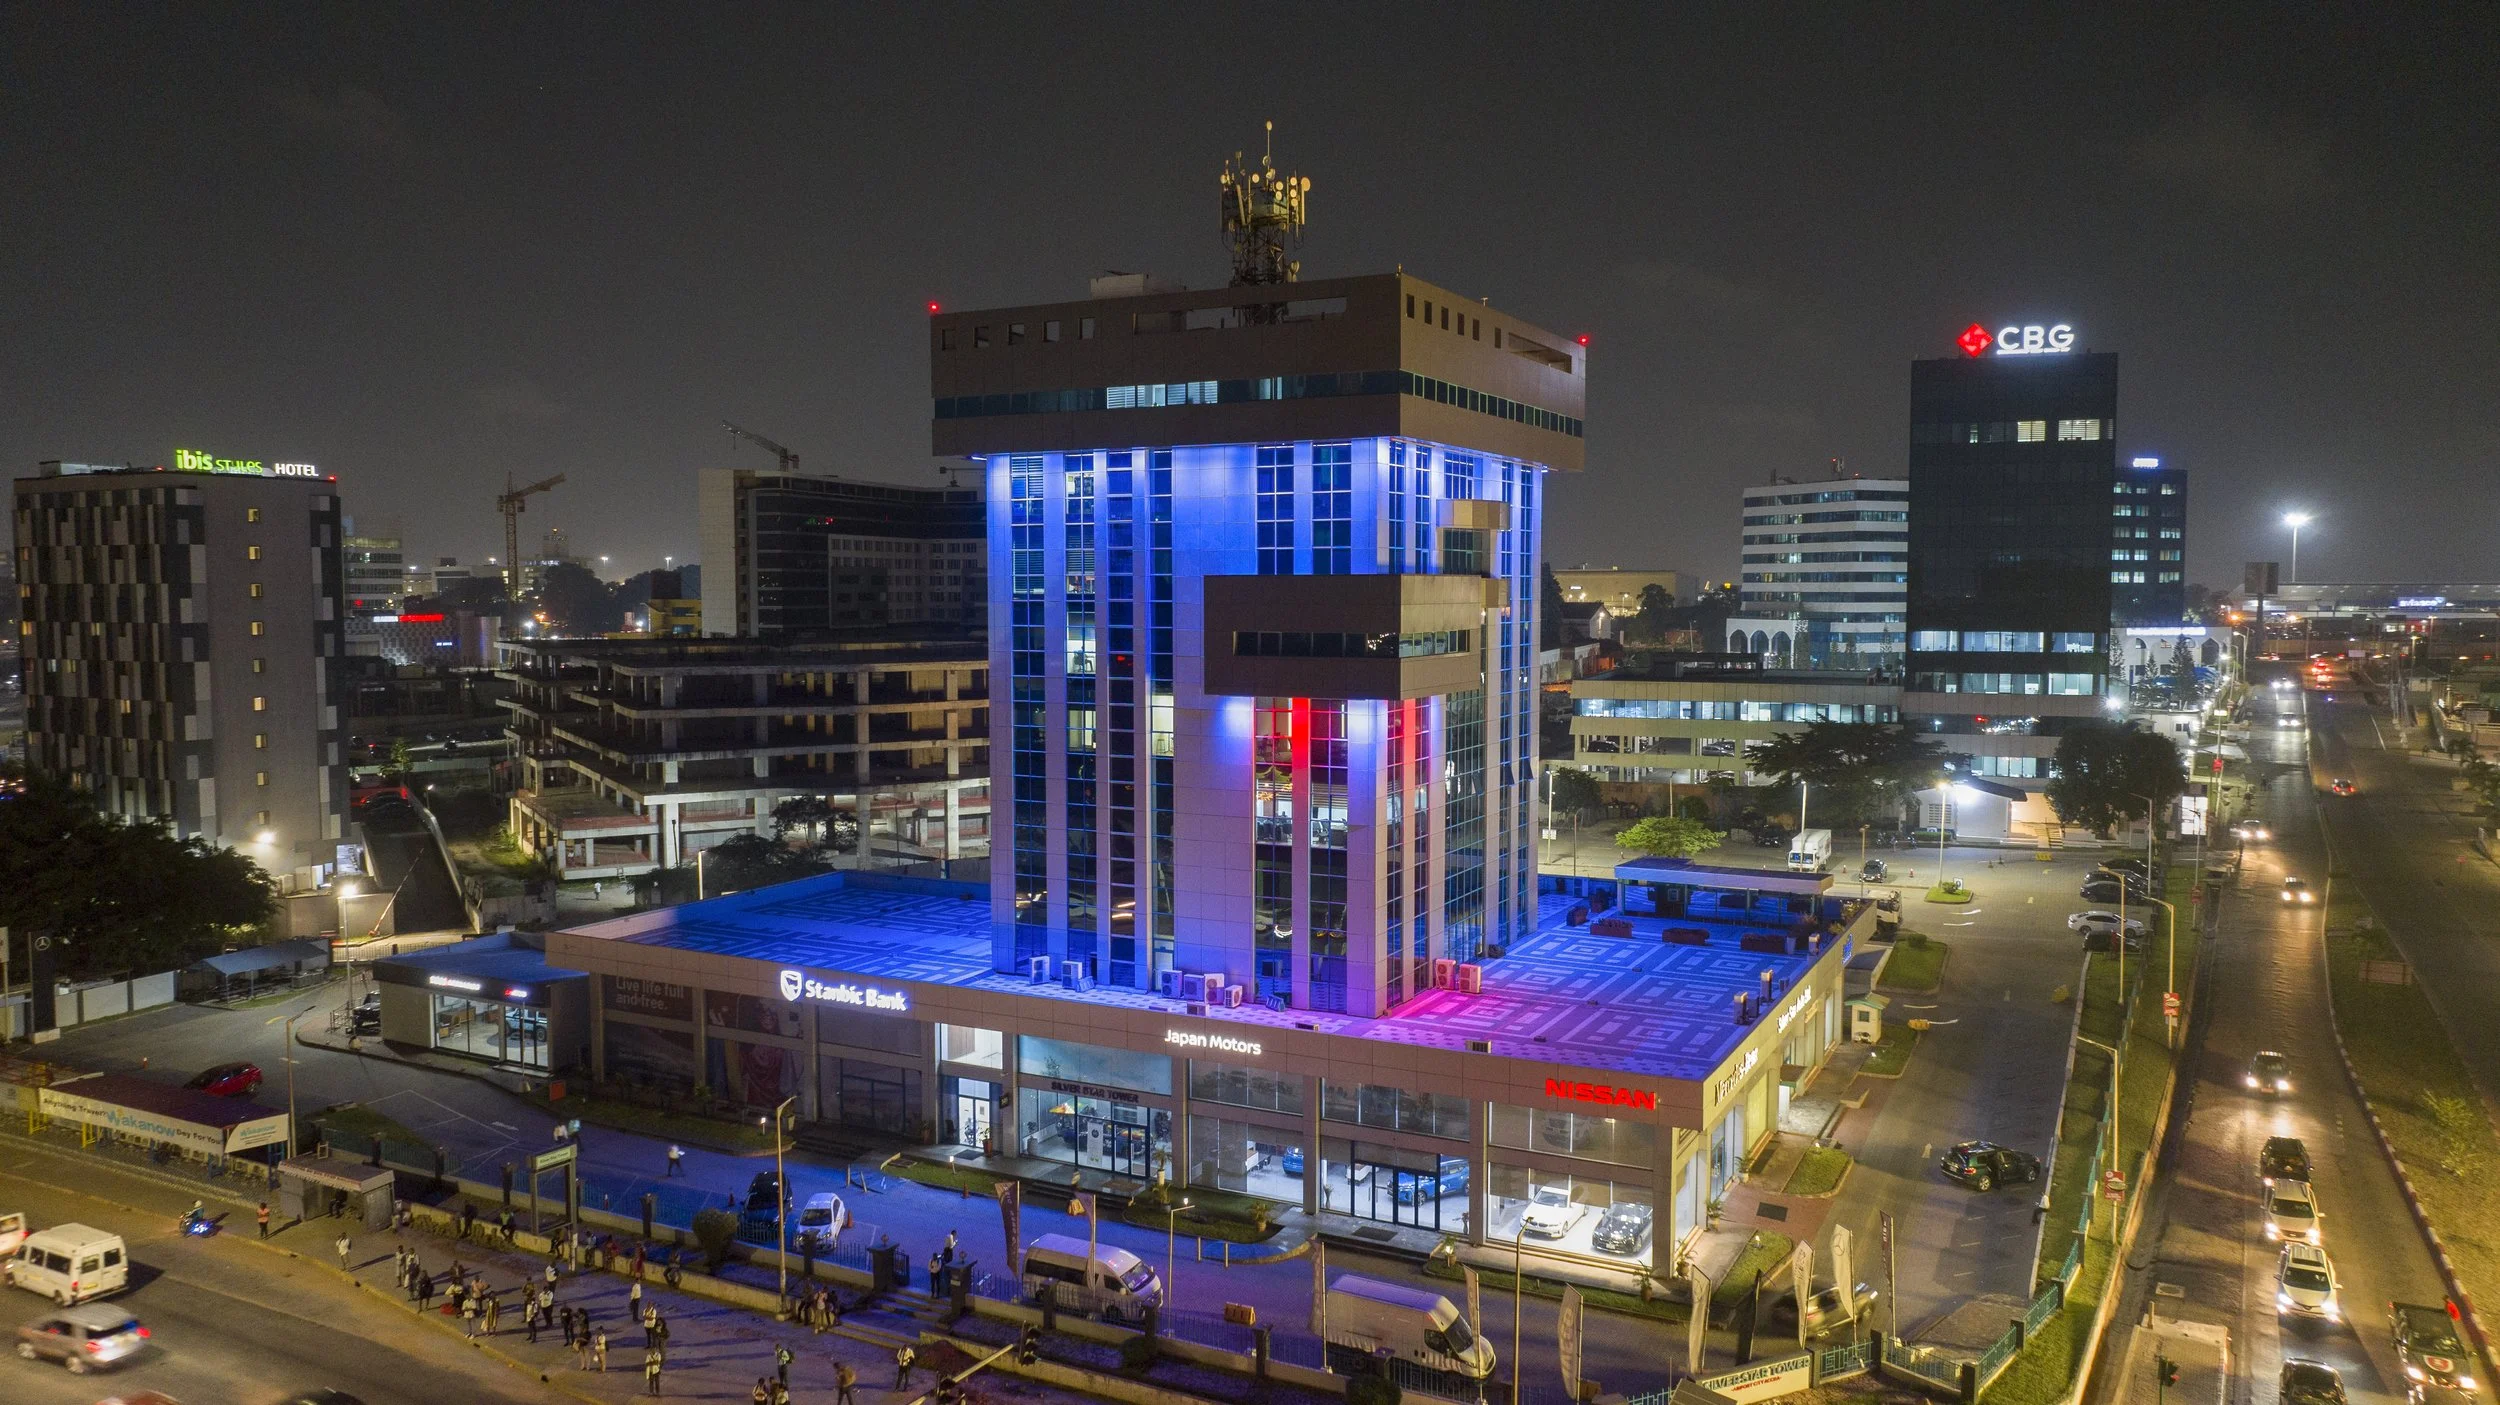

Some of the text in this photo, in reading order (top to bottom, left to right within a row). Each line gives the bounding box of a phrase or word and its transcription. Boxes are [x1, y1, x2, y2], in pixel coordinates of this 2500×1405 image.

[1997, 324, 2075, 352] CBG
[176, 449, 213, 470] ibis
[275, 462, 319, 477] HOTEL
[616, 976, 684, 998] Live life full
[805, 979, 907, 1011] Stanbic Bank
[616, 993, 668, 1010] and free.
[1165, 1029, 1262, 1055] Japan Motors
[1051, 1081, 1139, 1103] SILVER STAR TOWER
[1545, 1078, 1657, 1111] NISSAN
[107, 1109, 176, 1137] Wakanow
[1702, 1358, 1810, 1391] SILVER STAR TOWER
